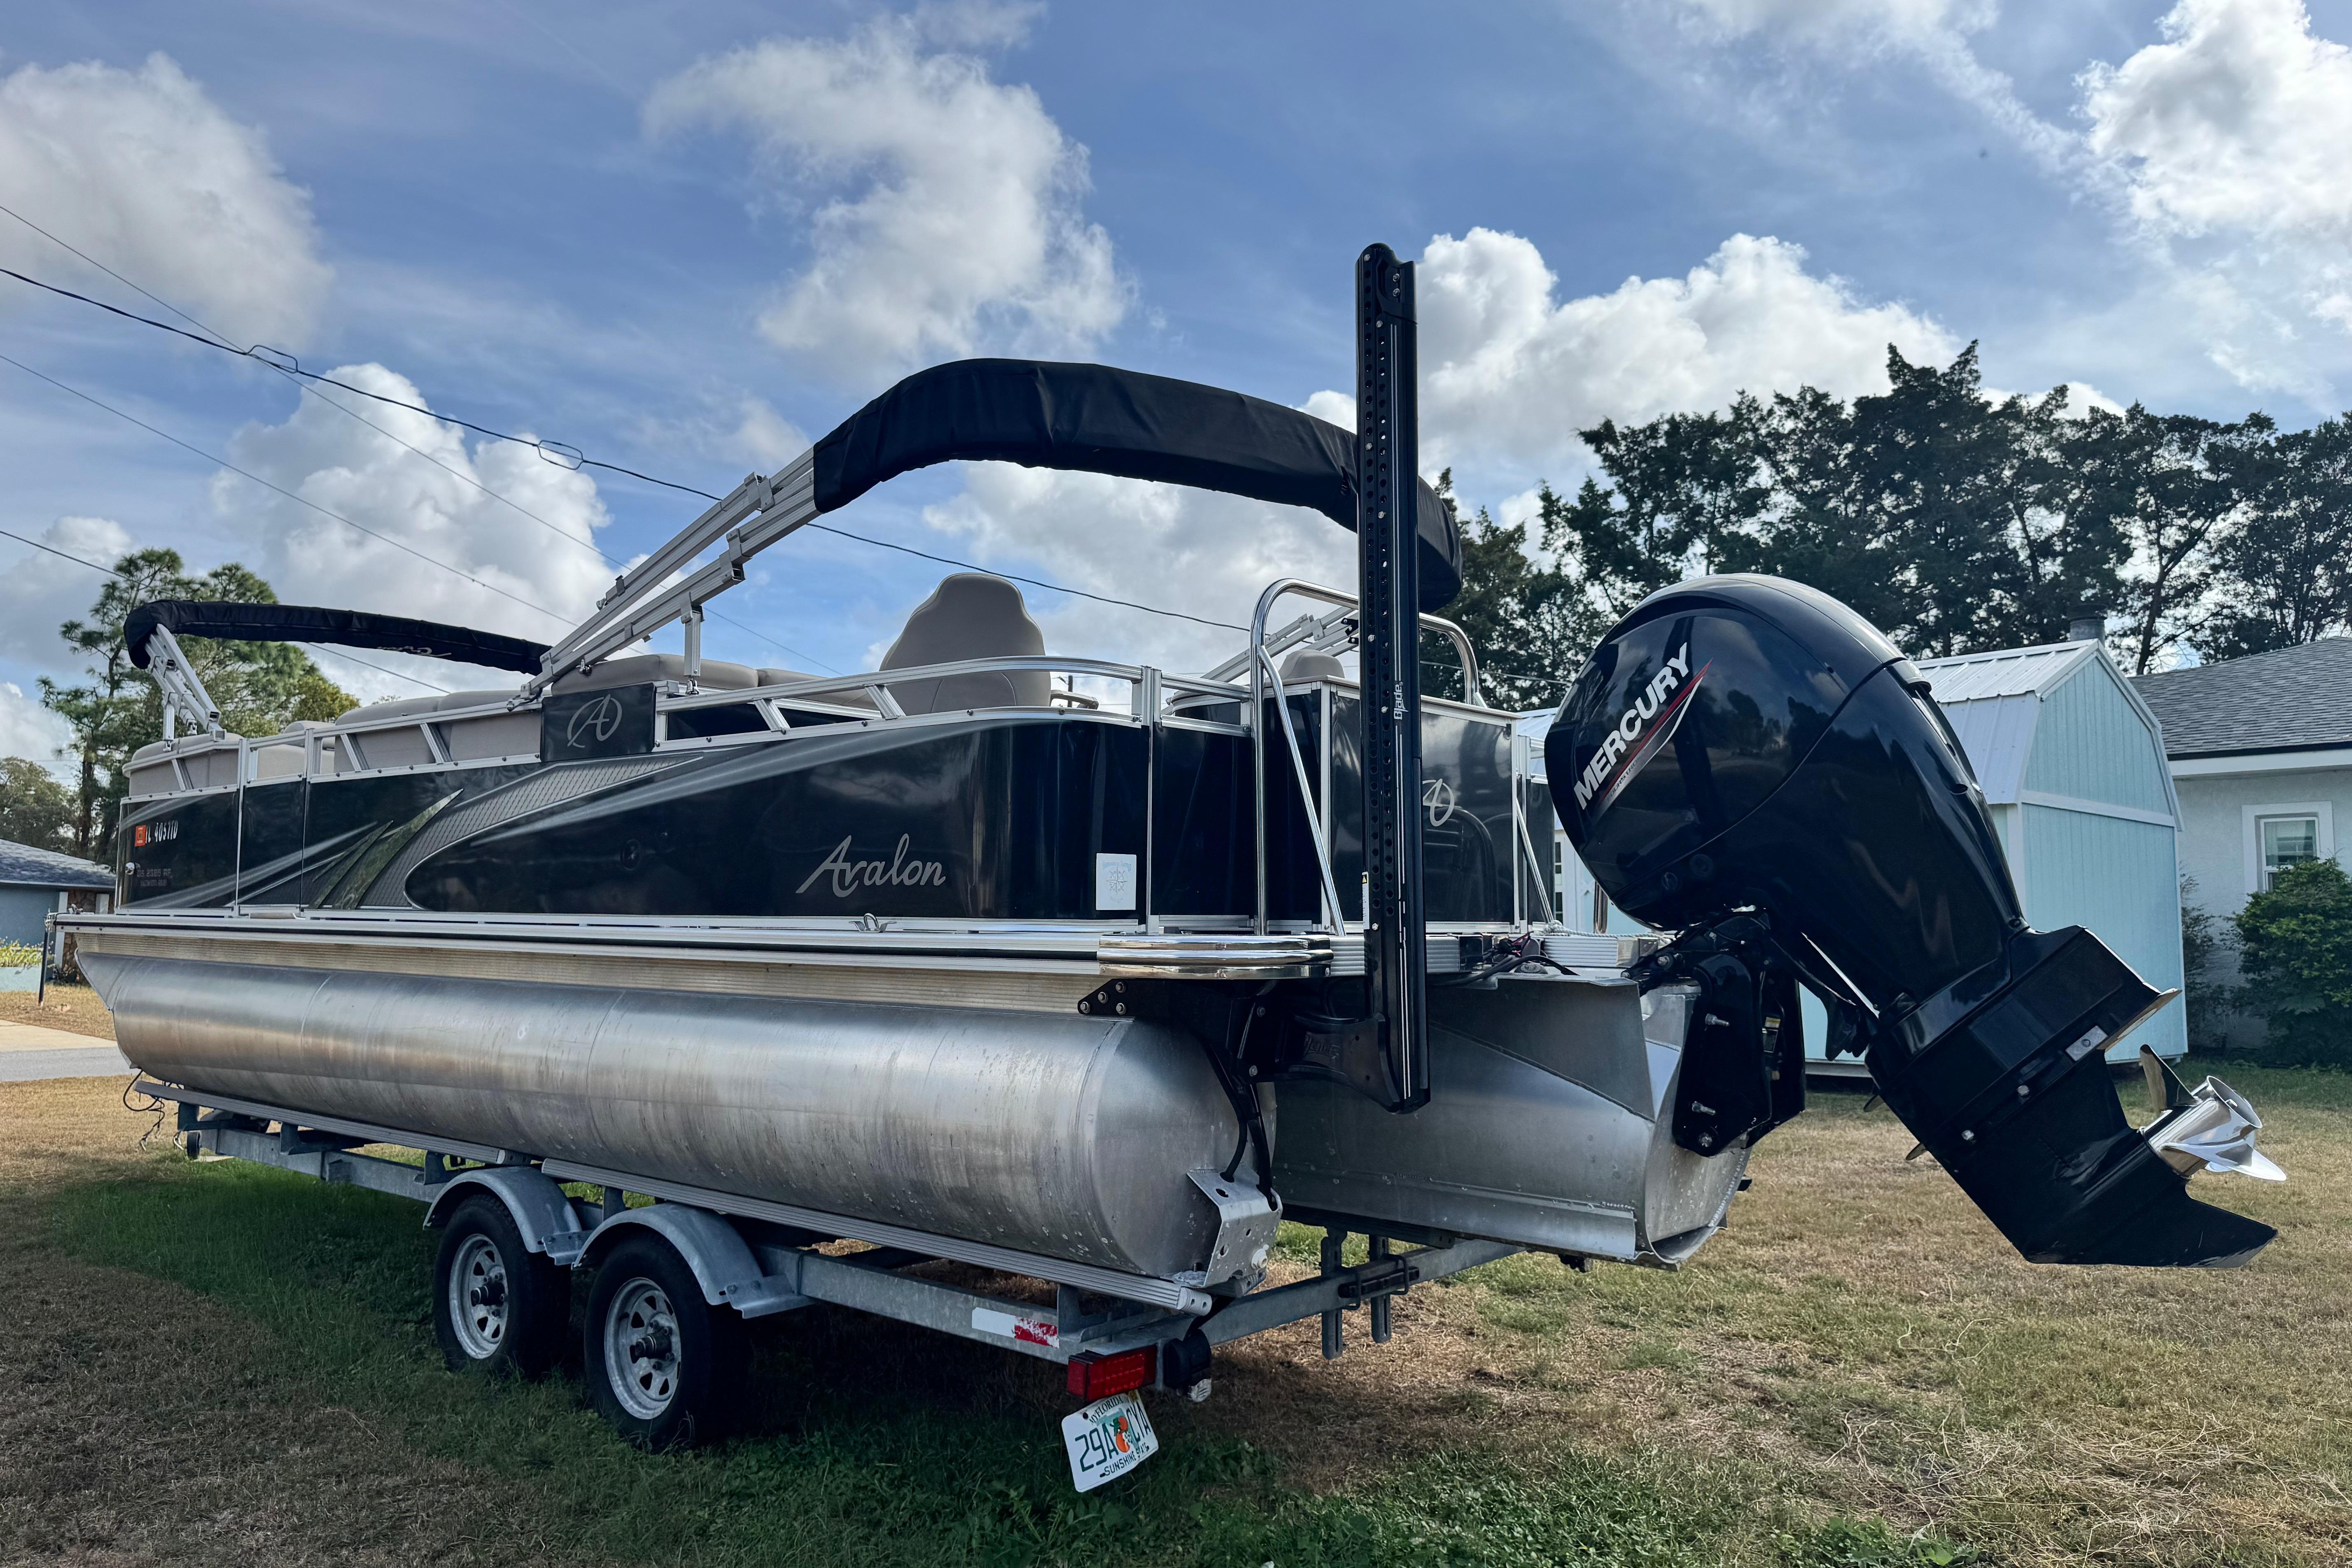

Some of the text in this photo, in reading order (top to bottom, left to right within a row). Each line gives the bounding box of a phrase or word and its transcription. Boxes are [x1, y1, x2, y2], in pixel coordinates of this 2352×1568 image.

[1393, 684, 1409, 721] Blade
[1574, 642, 1689, 810] MERCURY
[795, 833, 946, 897] Avalon
[1104, 1451, 1136, 1476] SUNSHINE
